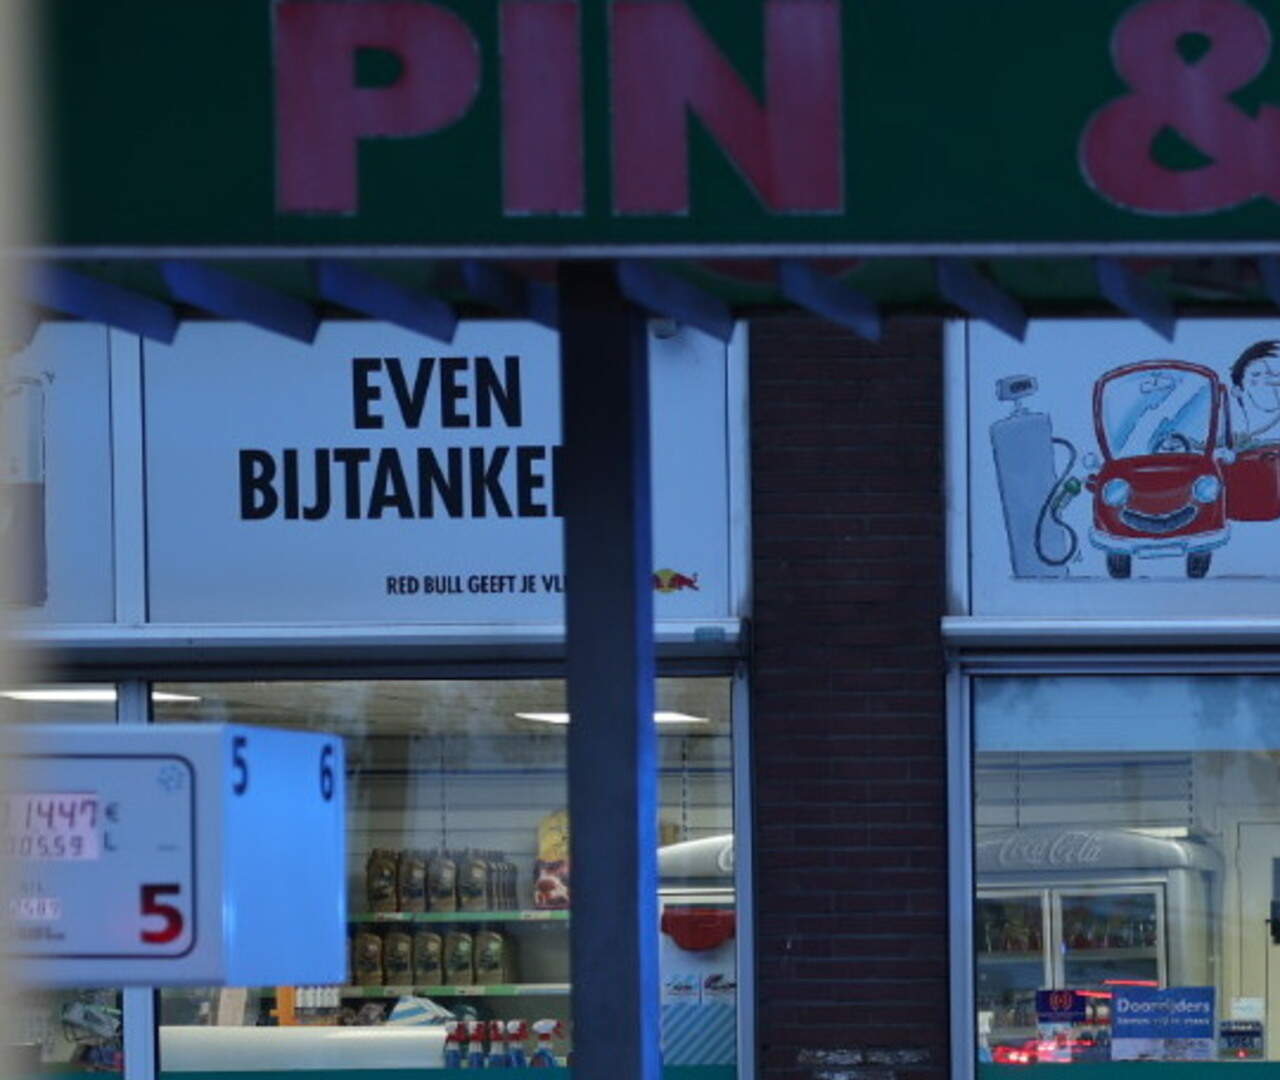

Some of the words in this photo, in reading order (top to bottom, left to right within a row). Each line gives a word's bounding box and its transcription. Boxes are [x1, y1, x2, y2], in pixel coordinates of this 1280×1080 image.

[272, 0, 844, 216] PIN
[353, 356, 522, 429] EVEN
[239, 445, 564, 521] BIJTANKE
[386, 575, 420, 595] RED
[424, 575, 463, 594] BULL
[467, 574, 516, 593] GEEFT
[519, 574, 537, 593] JE
[231, 735, 249, 798] 5
[318, 743, 335, 802] 6
[139, 883, 184, 945] 5
